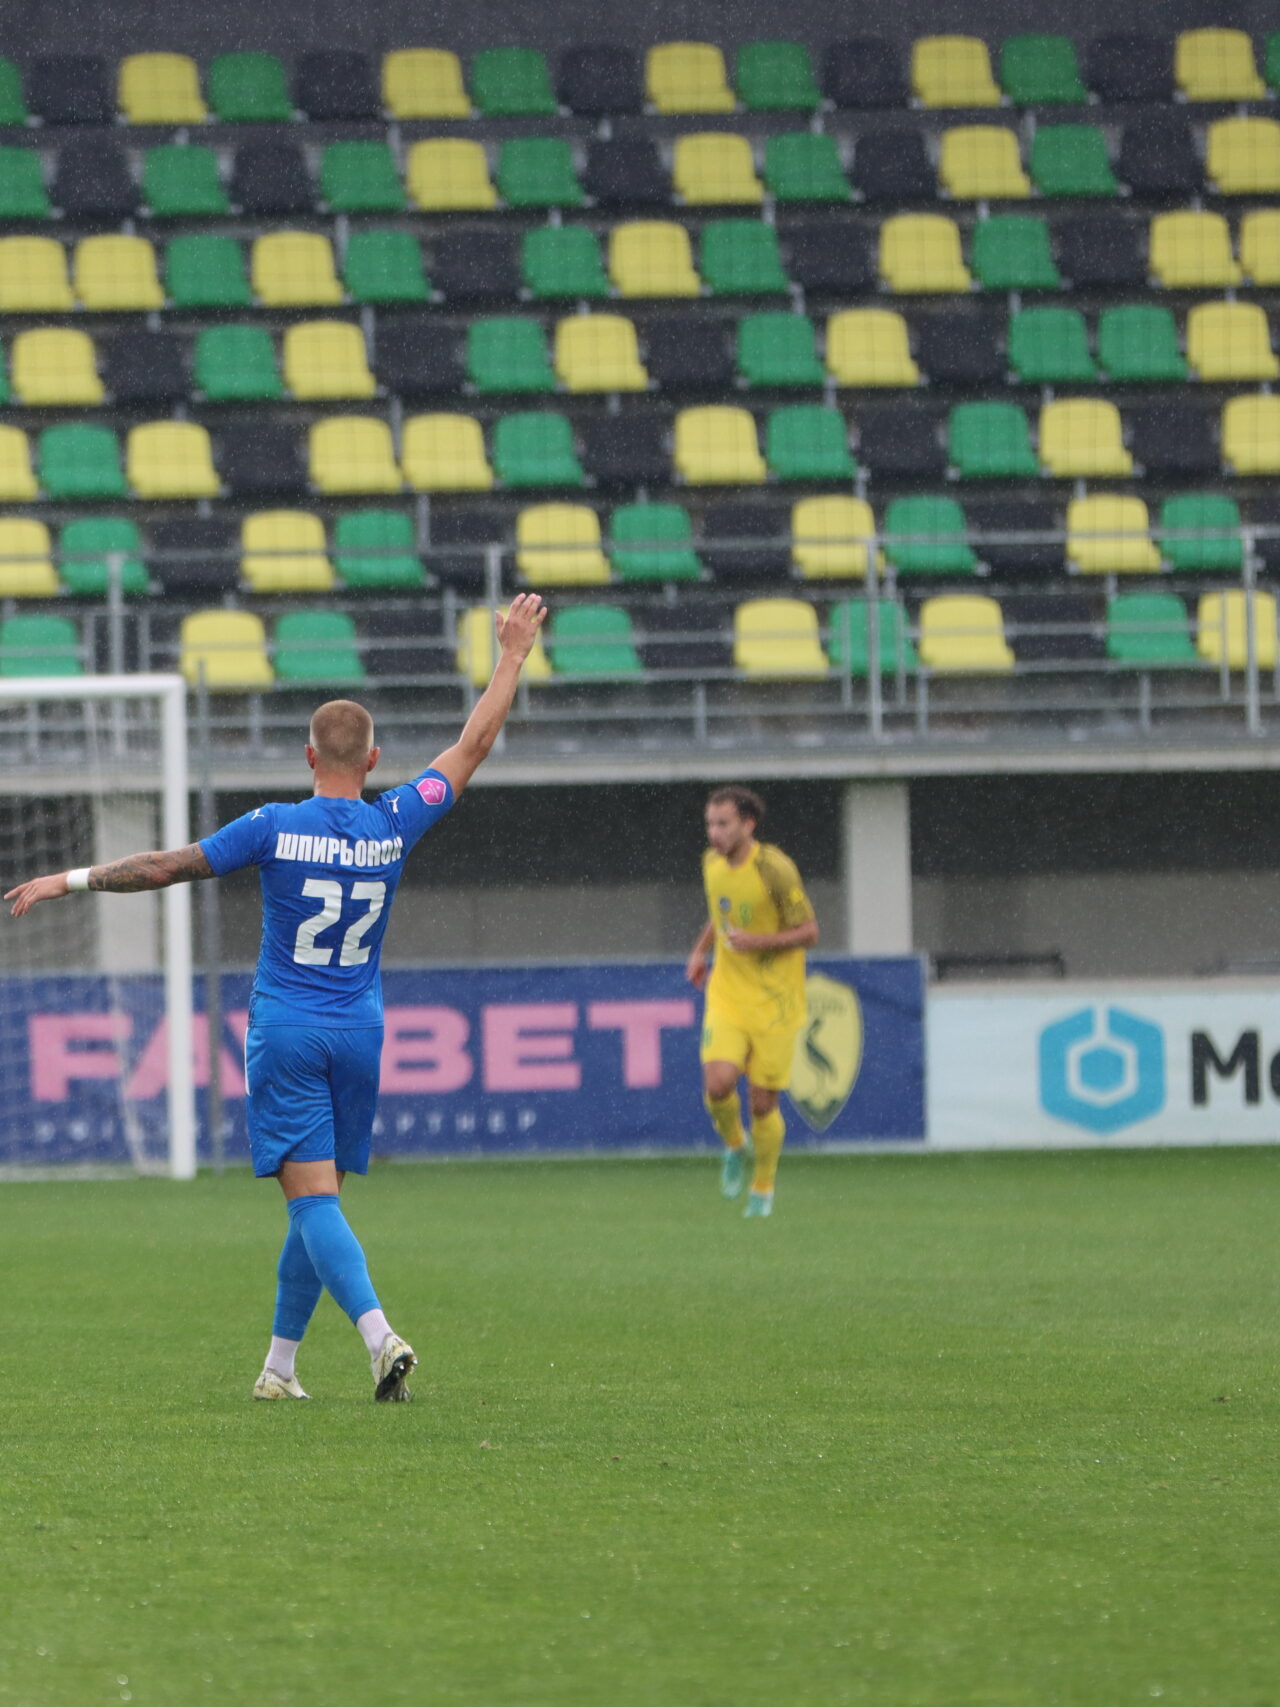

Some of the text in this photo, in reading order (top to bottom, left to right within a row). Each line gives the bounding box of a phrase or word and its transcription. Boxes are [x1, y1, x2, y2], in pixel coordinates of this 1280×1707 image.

[293, 878, 387, 967] 22
[28, 998, 695, 1103] FABET
[1191, 1029, 1280, 1107] M
